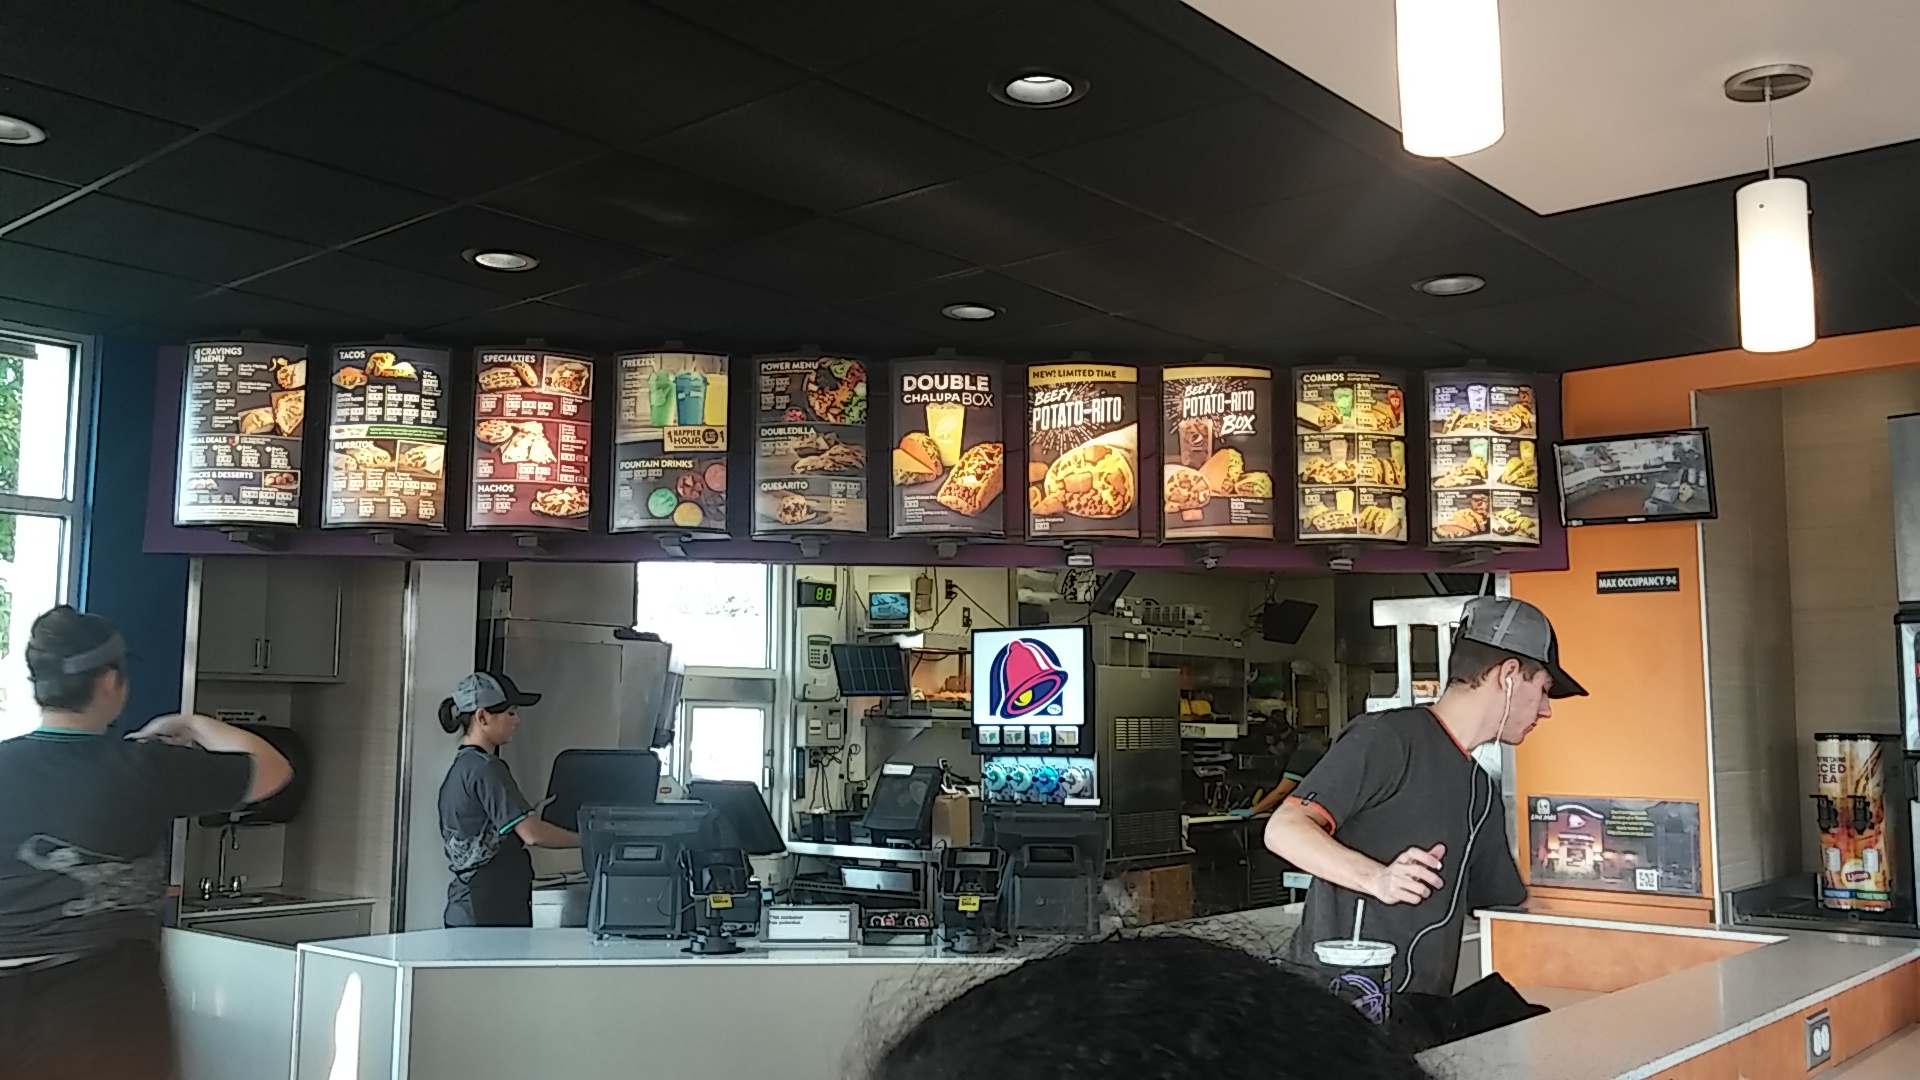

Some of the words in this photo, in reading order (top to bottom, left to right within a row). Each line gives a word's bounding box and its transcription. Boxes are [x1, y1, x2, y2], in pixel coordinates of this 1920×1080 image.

[200, 347, 243, 356] CRAVINGS
[339, 351, 366, 359] TACOS
[483, 355, 536, 363] SPECIALTIES
[622, 358, 656, 367] FREEZES
[761, 362, 791, 370] POWER
[792, 361, 818, 369] MENU
[1032, 370, 1056, 378] NEW!
[1058, 369, 1095, 378] LIMITED
[1096, 370, 1117, 378] TIME
[1302, 373, 1345, 382] COMBOS
[903, 374, 990, 392] DOUBLE
[1184, 382, 1217, 397] BEEFY
[903, 392, 961, 403] CHALUPA
[961, 392, 994, 407] BOX
[1035, 387, 1074, 406] BEEFY
[1182, 390, 1255, 419] POTATO-RITO
[1032, 396, 1122, 433] POTATO-RITO
[1219, 414, 1256, 435] BOX
[761, 427, 815, 436] DOUBLEDILLA
[334, 441, 374, 450] BURRITOS
[673, 437, 701, 445] HOUR
[620, 461, 660, 469] FOUNTAIN
[661, 460, 694, 468] DRINKS
[217, 471, 254, 479] DESSERTS
[477, 484, 515, 493] NACHOS
[760, 482, 808, 491] QUESARITO
[1598, 578, 1617, 588] MAX
[1618, 575, 1665, 588] OCCUPANCY
[1665, 575, 1677, 586] 94
[816, 587, 833, 601] 88
